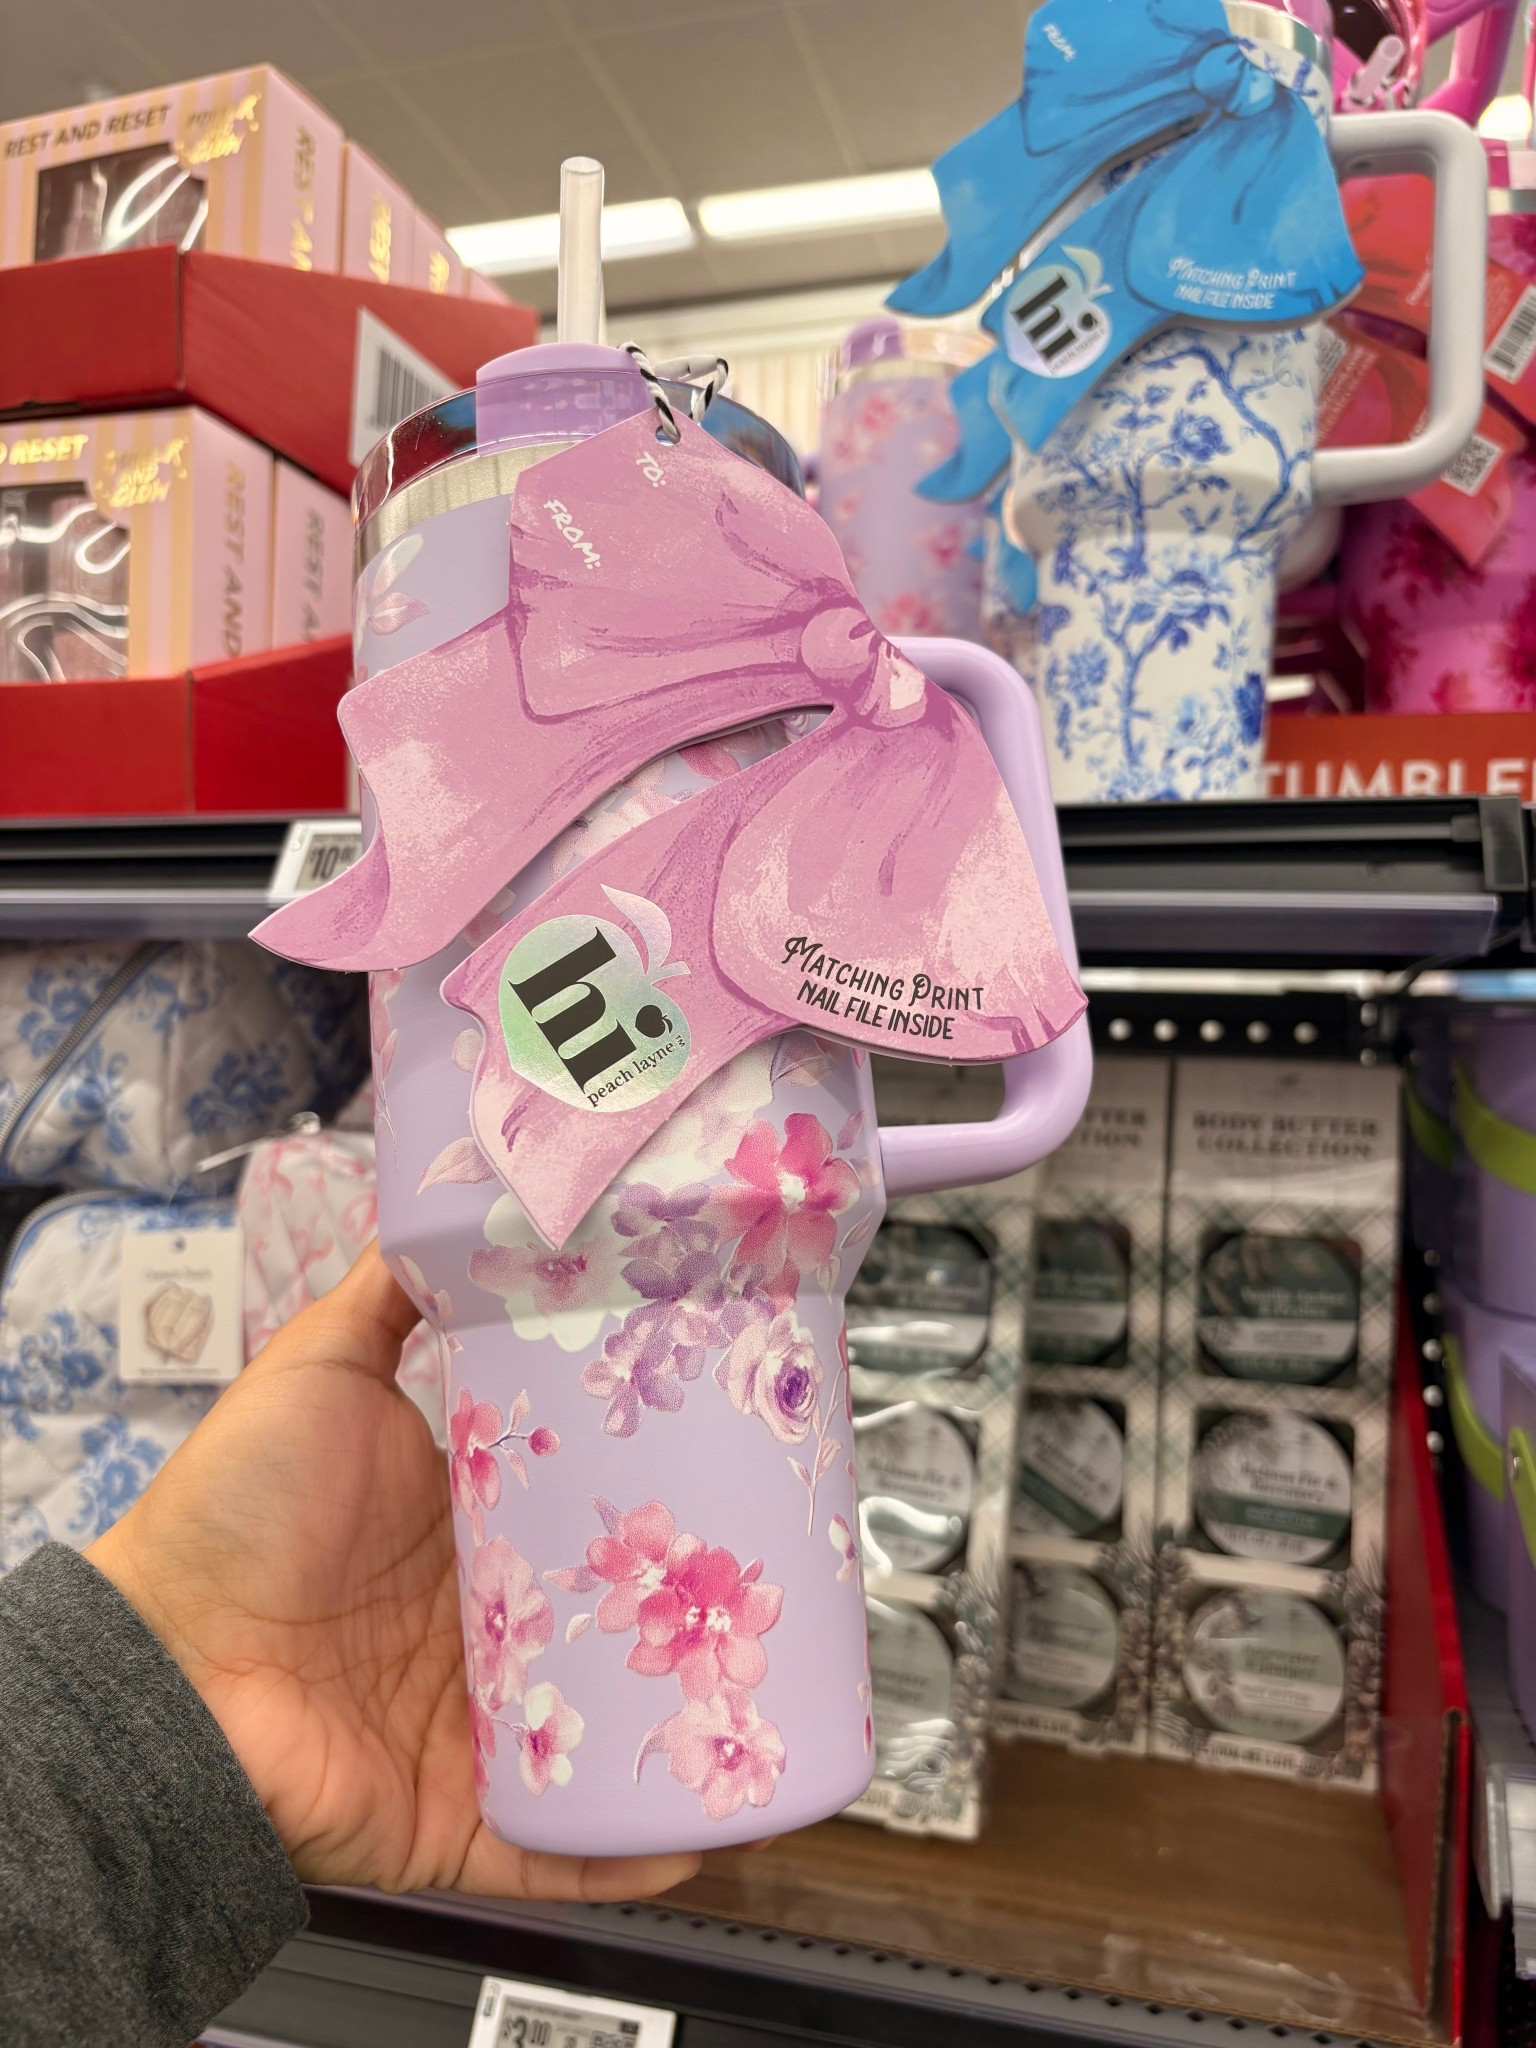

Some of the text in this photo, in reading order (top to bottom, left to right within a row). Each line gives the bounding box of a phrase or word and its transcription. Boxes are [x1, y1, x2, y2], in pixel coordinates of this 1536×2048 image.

[4, 104, 171, 159] REST AND RESET
[1243, 266, 1298, 292] PRINT
[9, 434, 89, 465] RESET
[636, 451, 667, 488] TO:
[223, 458, 246, 565] REST
[543, 499, 601, 570] FROM:
[1262, 757, 1536, 798] TUMBLE
[797, 979, 956, 1040] NAIL FILE INSIDE
[586, 1069, 635, 1108] peach
[635, 1041, 675, 1075] layne
[1193, 1109, 1378, 1138] BODY BUTTER
[1196, 1134, 1374, 1159] COLLECTION
